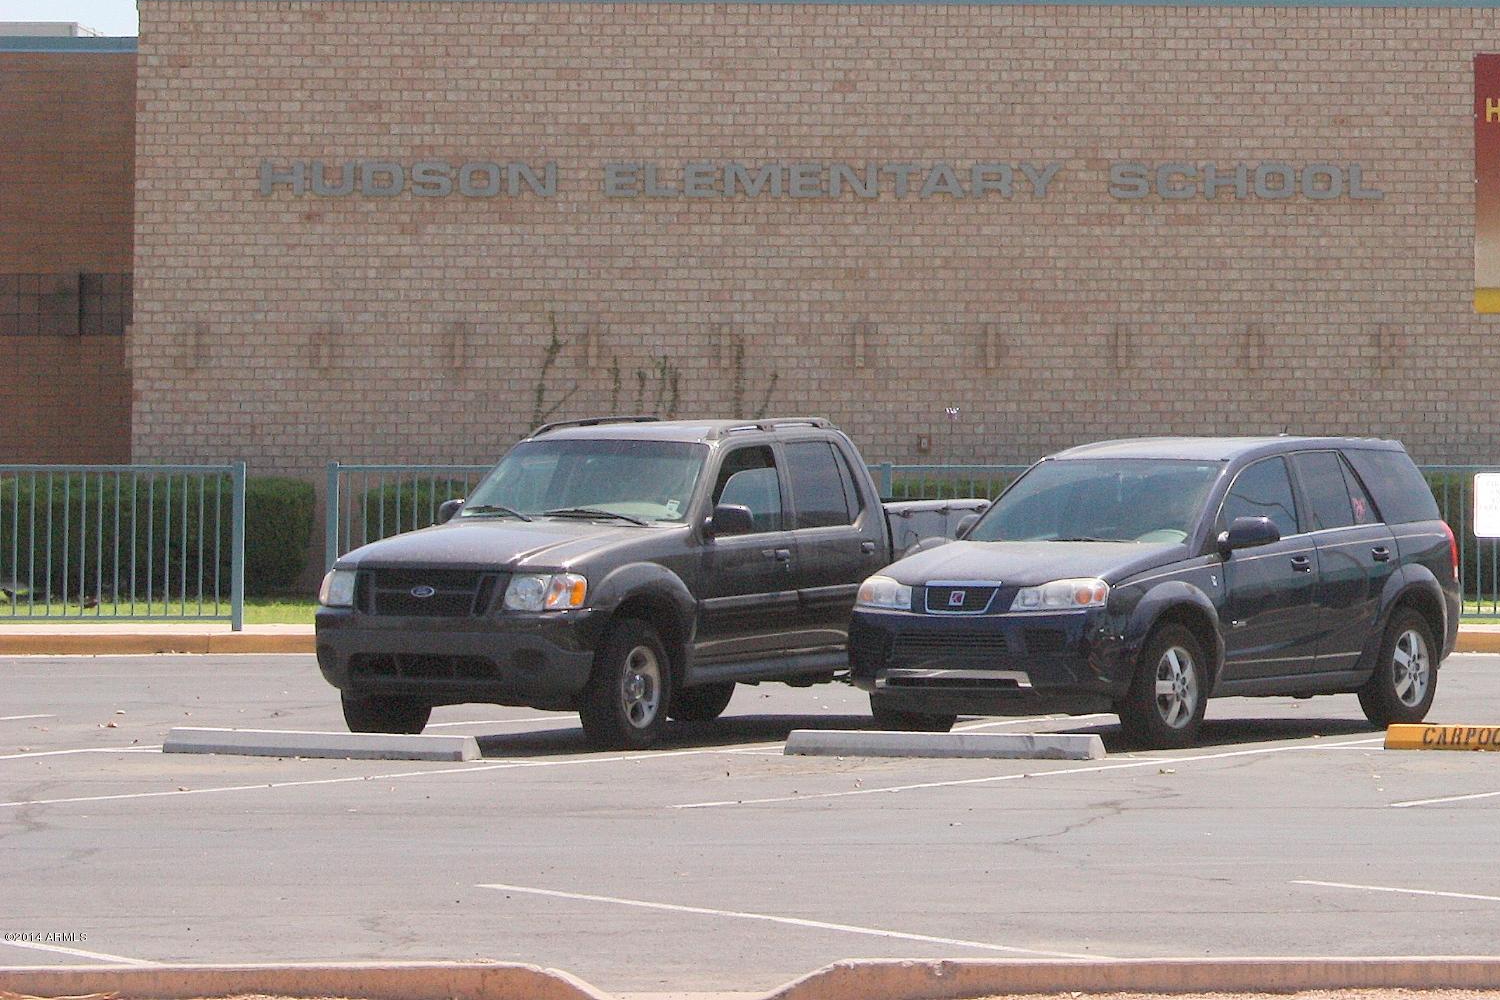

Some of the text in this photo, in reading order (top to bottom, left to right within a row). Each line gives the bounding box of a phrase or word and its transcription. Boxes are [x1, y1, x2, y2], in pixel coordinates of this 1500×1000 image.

[259, 158, 1384, 199] HUDSON ELEMENTARY SCHOOL
